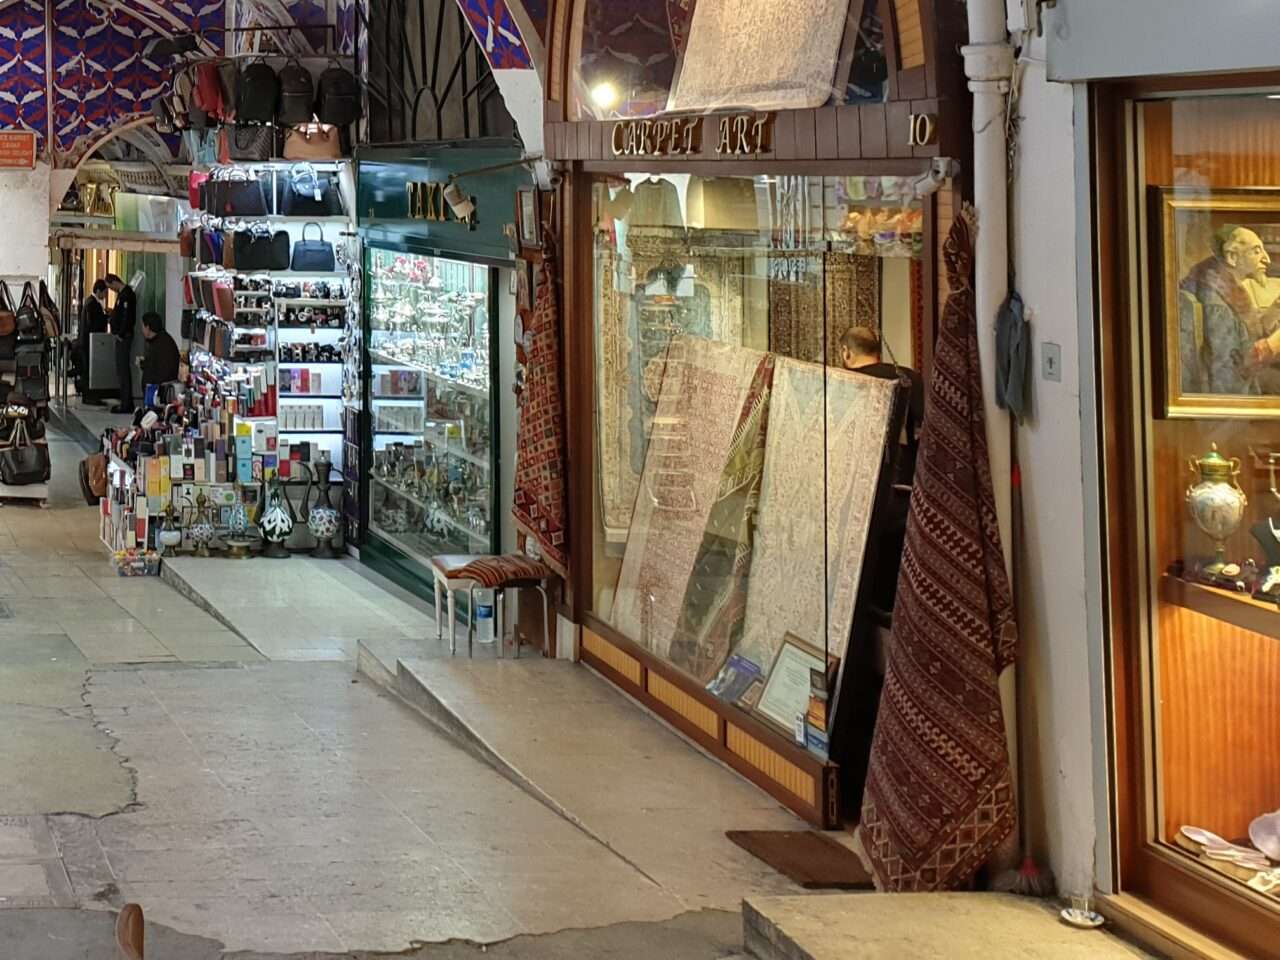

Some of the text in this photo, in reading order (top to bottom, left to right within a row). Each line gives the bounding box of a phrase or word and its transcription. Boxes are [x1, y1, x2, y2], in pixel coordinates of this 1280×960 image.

[611, 112, 769, 156] CARPET ART
[907, 114, 930, 146] 10
